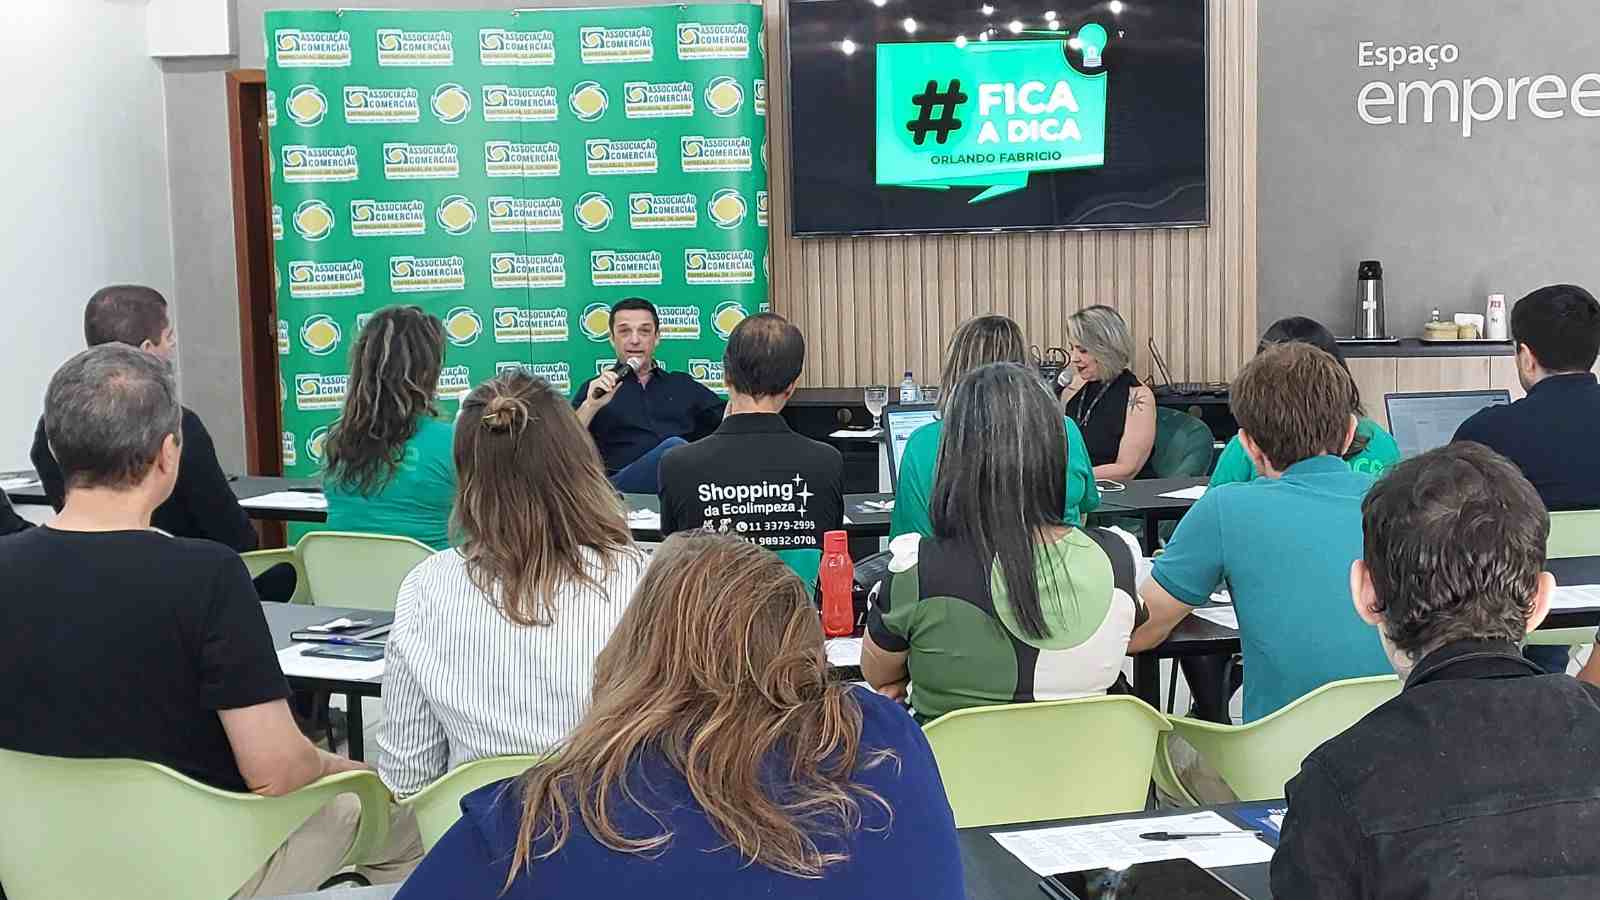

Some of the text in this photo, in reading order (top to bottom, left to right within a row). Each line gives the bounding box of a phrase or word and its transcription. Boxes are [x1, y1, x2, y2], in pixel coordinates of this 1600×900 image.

[701, 36, 747, 44] COMERCIAL
[302, 43, 348, 51] COMERCIAL
[403, 43, 450, 51] COMERCIAL
[1358, 41, 1459, 72] Espaço
[649, 94, 691, 102] COMERCIAL
[978, 80, 1079, 116] FICA
[370, 100, 416, 108] COMERCIAL
[977, 118, 1081, 144] A DICA
[705, 148, 750, 157] COMERCIAL
[410, 156, 456, 164] COMERCIAL
[930, 151, 1062, 165] ORLANDO FABRICIO
[514, 208, 560, 216] COMERCIAL
[654, 206, 695, 214] COMERCIAL
[516, 265, 563, 273] COMERCIAL
[616, 263, 659, 271] COMERCIAL
[708, 261, 752, 269] COMERCIAL
[416, 268, 462, 276] COMERCIAL
[316, 272, 362, 281] COMERCIAL
[520, 320, 565, 328] COMERCIAL
[440, 377, 468, 385] ERCIAL
[698, 481, 793, 502] Shopping
[704, 502, 795, 517] da Ecolimpeza
[749, 522, 761, 531] 11
